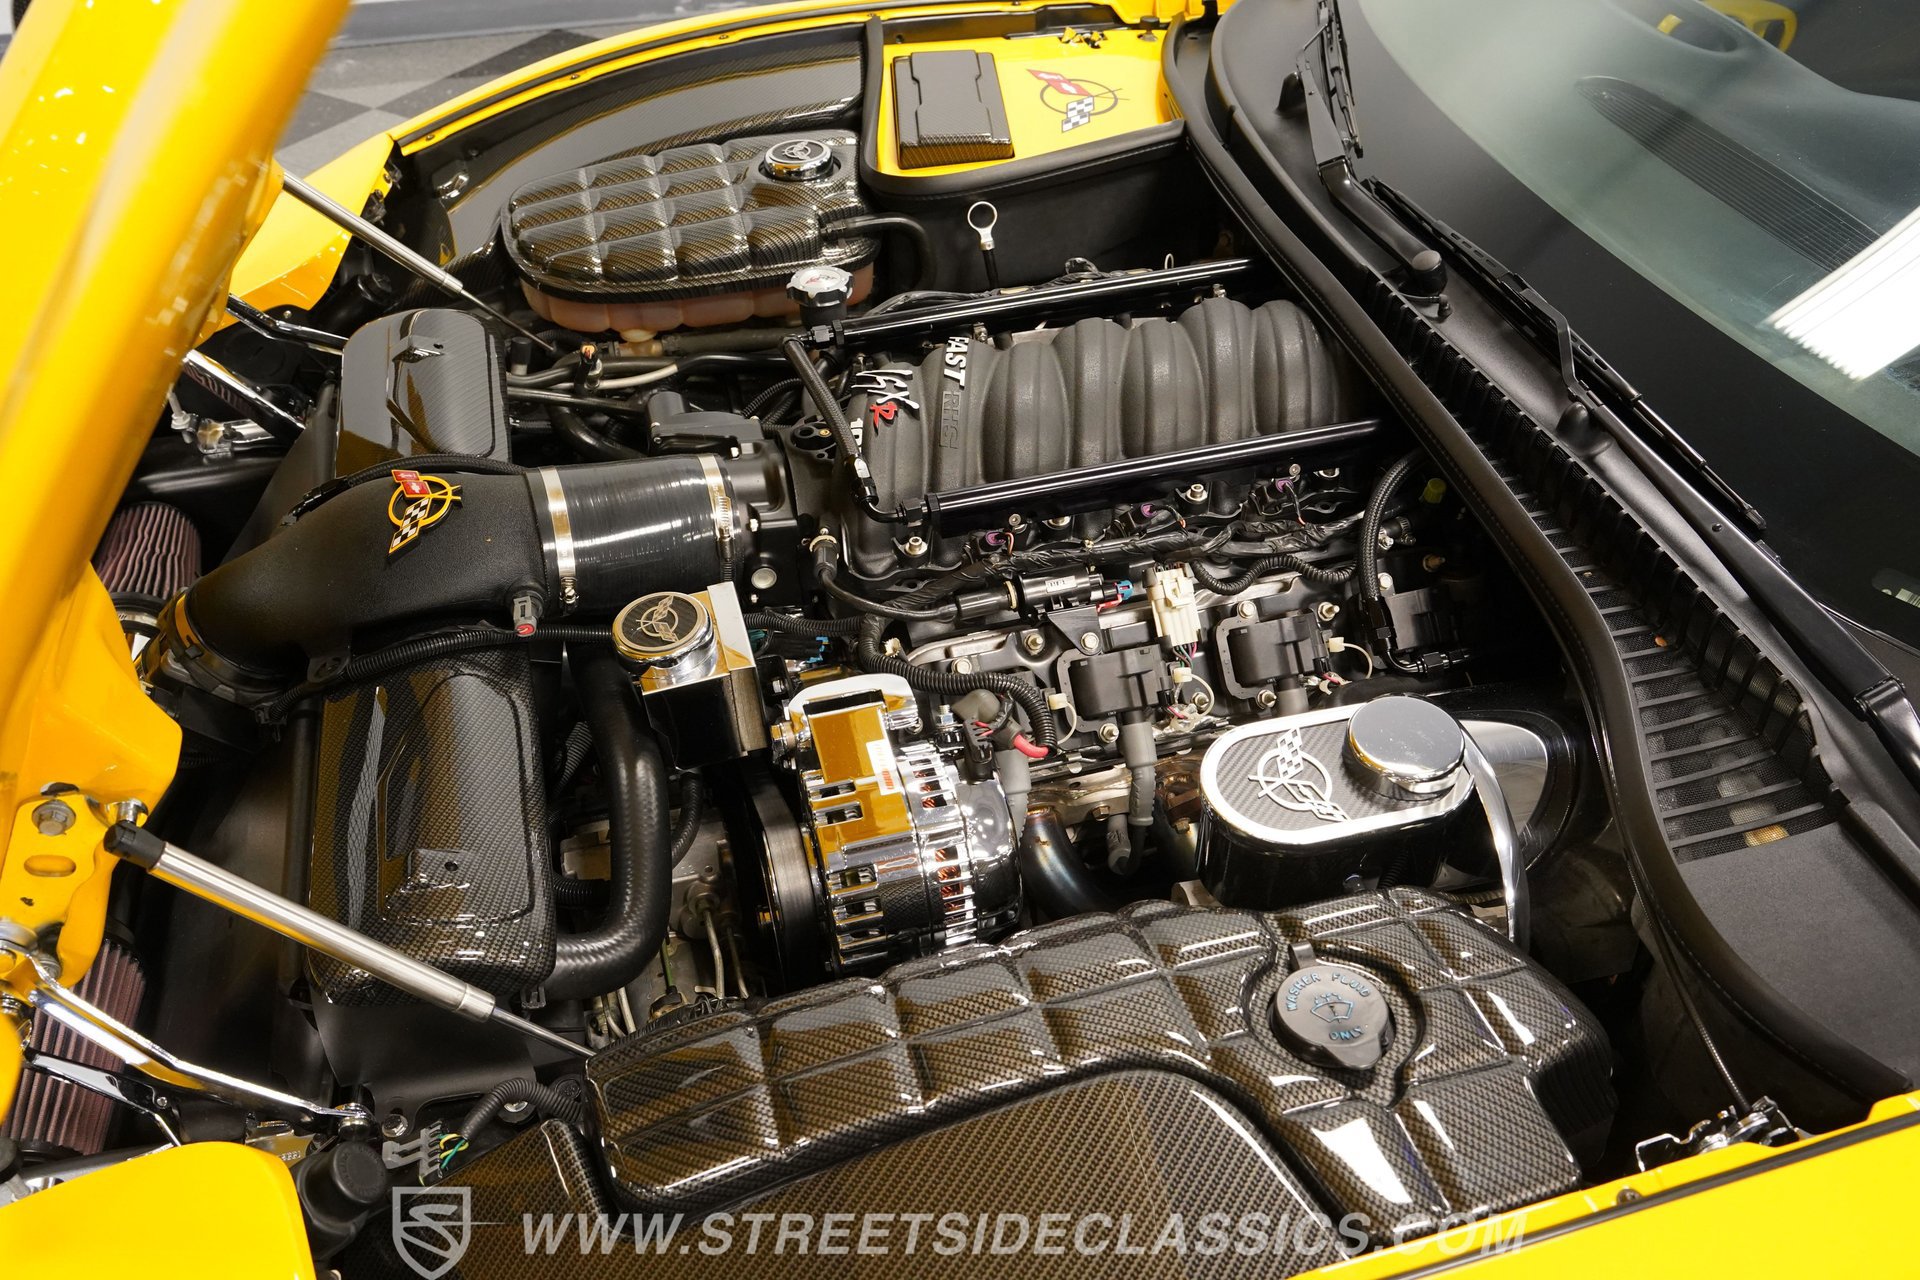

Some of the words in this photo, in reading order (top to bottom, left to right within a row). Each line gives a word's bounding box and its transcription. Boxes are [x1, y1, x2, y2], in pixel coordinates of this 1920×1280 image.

[943, 336, 970, 387] FAST
[1286, 972, 1321, 1011] WASHER
[1332, 972, 1371, 997] FLUID
[1329, 1025, 1363, 1040] ONLY
